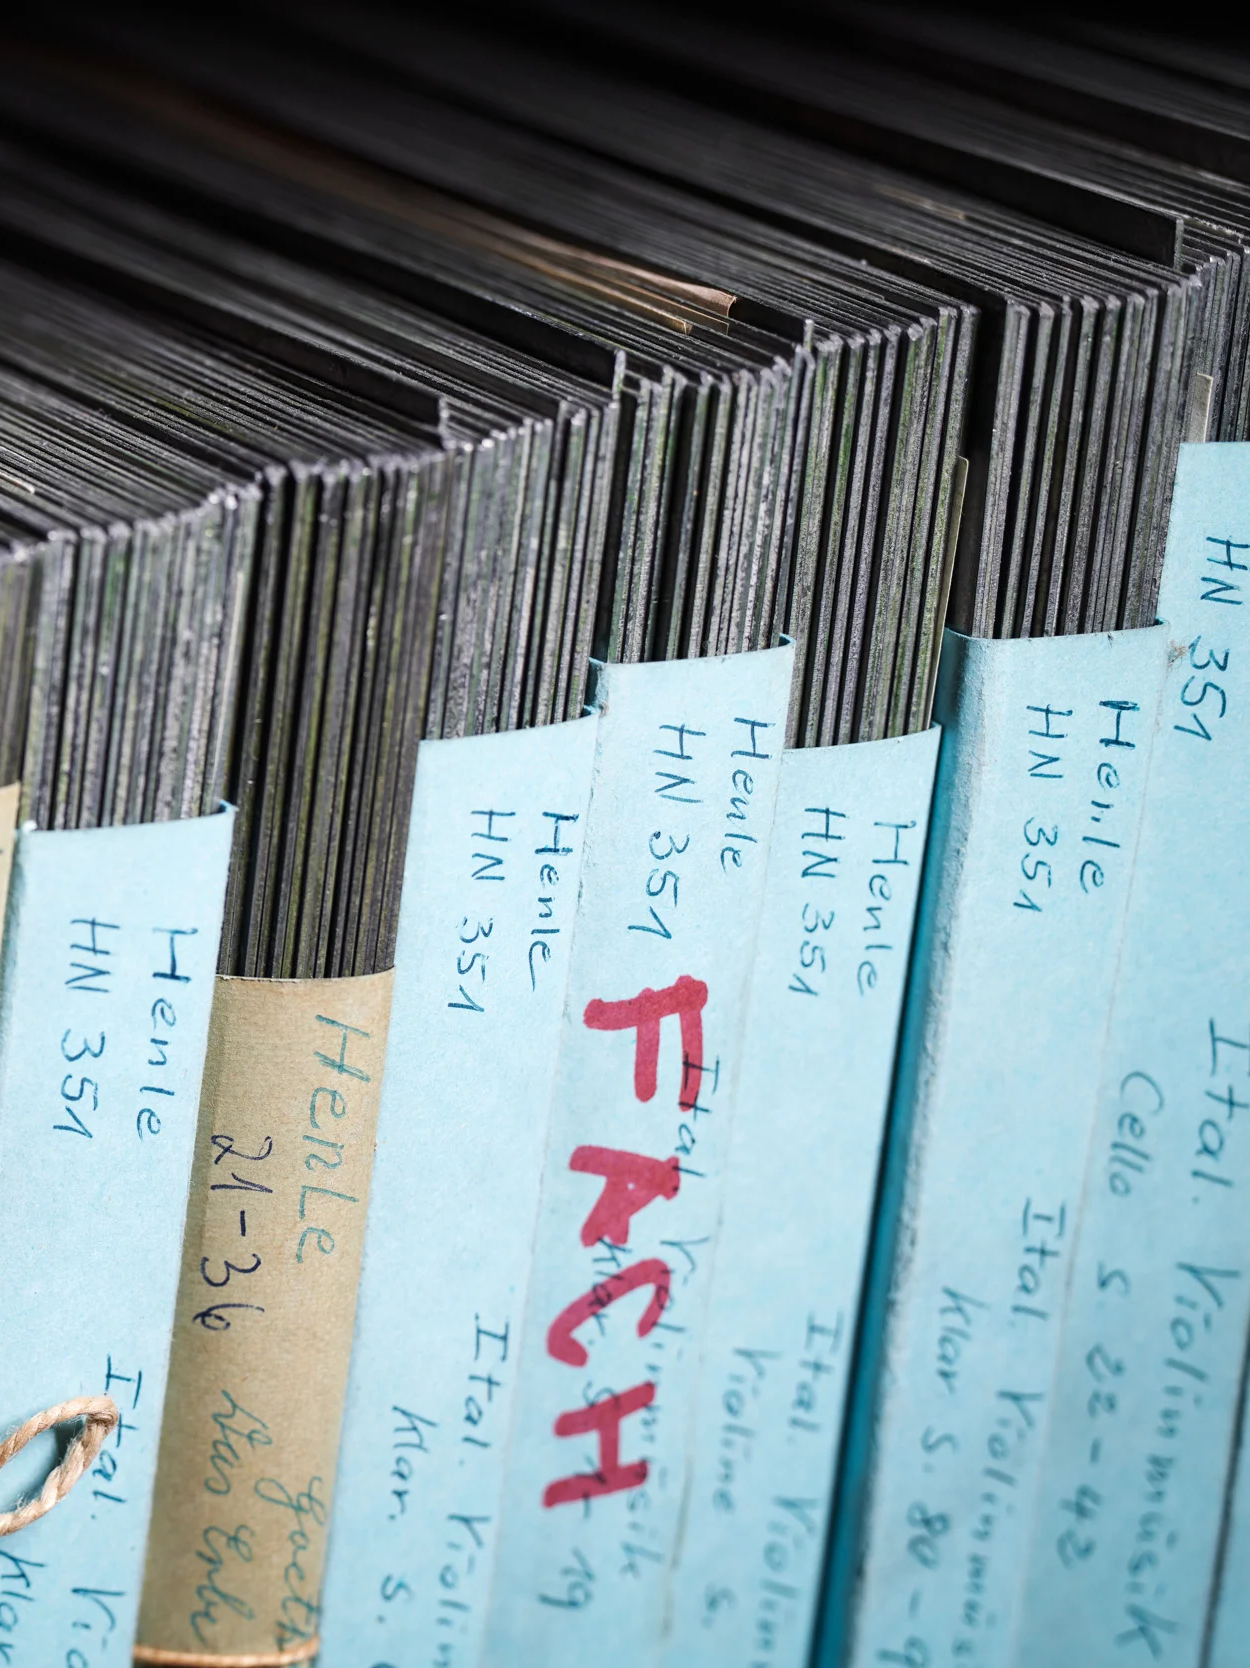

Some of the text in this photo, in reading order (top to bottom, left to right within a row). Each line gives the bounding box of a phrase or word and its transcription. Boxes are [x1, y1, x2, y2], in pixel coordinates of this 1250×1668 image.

[1174, 536, 1250, 742] HN 351
[628, 724, 706, 940] HN 351
[721, 717, 776, 872] Henle
[1013, 704, 1073, 913] HN 351
[1080, 700, 1140, 894] Henle
[448, 810, 516, 1013] HN 351
[528, 811, 579, 992] Henle
[788, 807, 846, 996] HN 351
[857, 819, 916, 996] Henle
[54, 917, 120, 1139] HN 351
[137, 927, 198, 1140] Henle
[1109, 1071, 1165, 1197] Cello
[542, 975, 708, 1509] FACH
